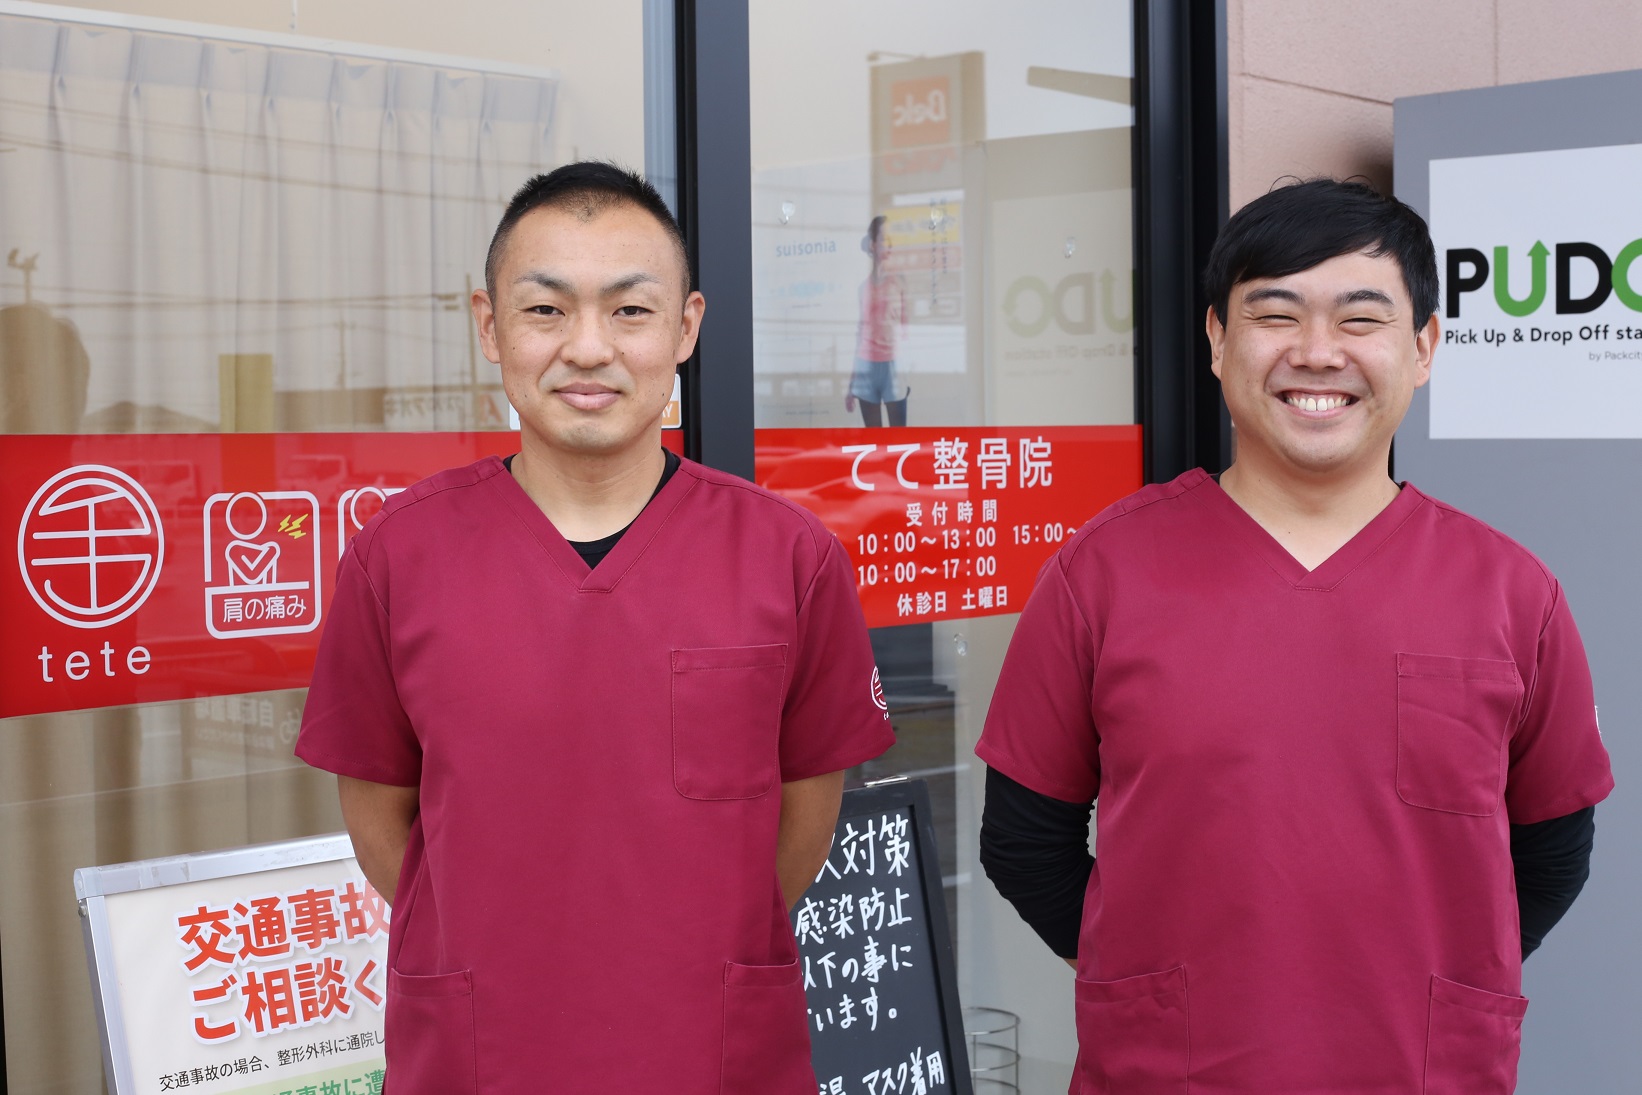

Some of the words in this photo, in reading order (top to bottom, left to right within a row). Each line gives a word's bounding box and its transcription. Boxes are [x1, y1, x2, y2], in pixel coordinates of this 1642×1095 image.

[776, 240, 837, 257] suisonia
[1445, 329, 1478, 344] Pick
[1484, 329, 1506, 347] Up
[1513, 328, 1524, 342] &
[1530, 327, 1573, 346] Drop
[1579, 325, 1610, 341] Off
[1616, 326, 1642, 340] sta
[1589, 352, 1601, 361] by
[841, 436, 1053, 491] てて整骨院
[906, 499, 998, 527] 受付時間
[223, 595, 307, 622] 肩の痛み
[897, 591, 947, 617] 休診日
[961, 585, 1008, 611] 土曜日
[38, 641, 151, 682] tete
[177, 879, 390, 972] 交通事故
[795, 887, 912, 945] 感染防止
[193, 957, 383, 1040] ご相談く
[807, 986, 898, 1031] います。
[159, 1031, 385, 1091] 交通事故の場合、整形外科に通院し
[862, 1046, 945, 1095] マスク着用
[272, 1069, 386, 1095] 故に遭
